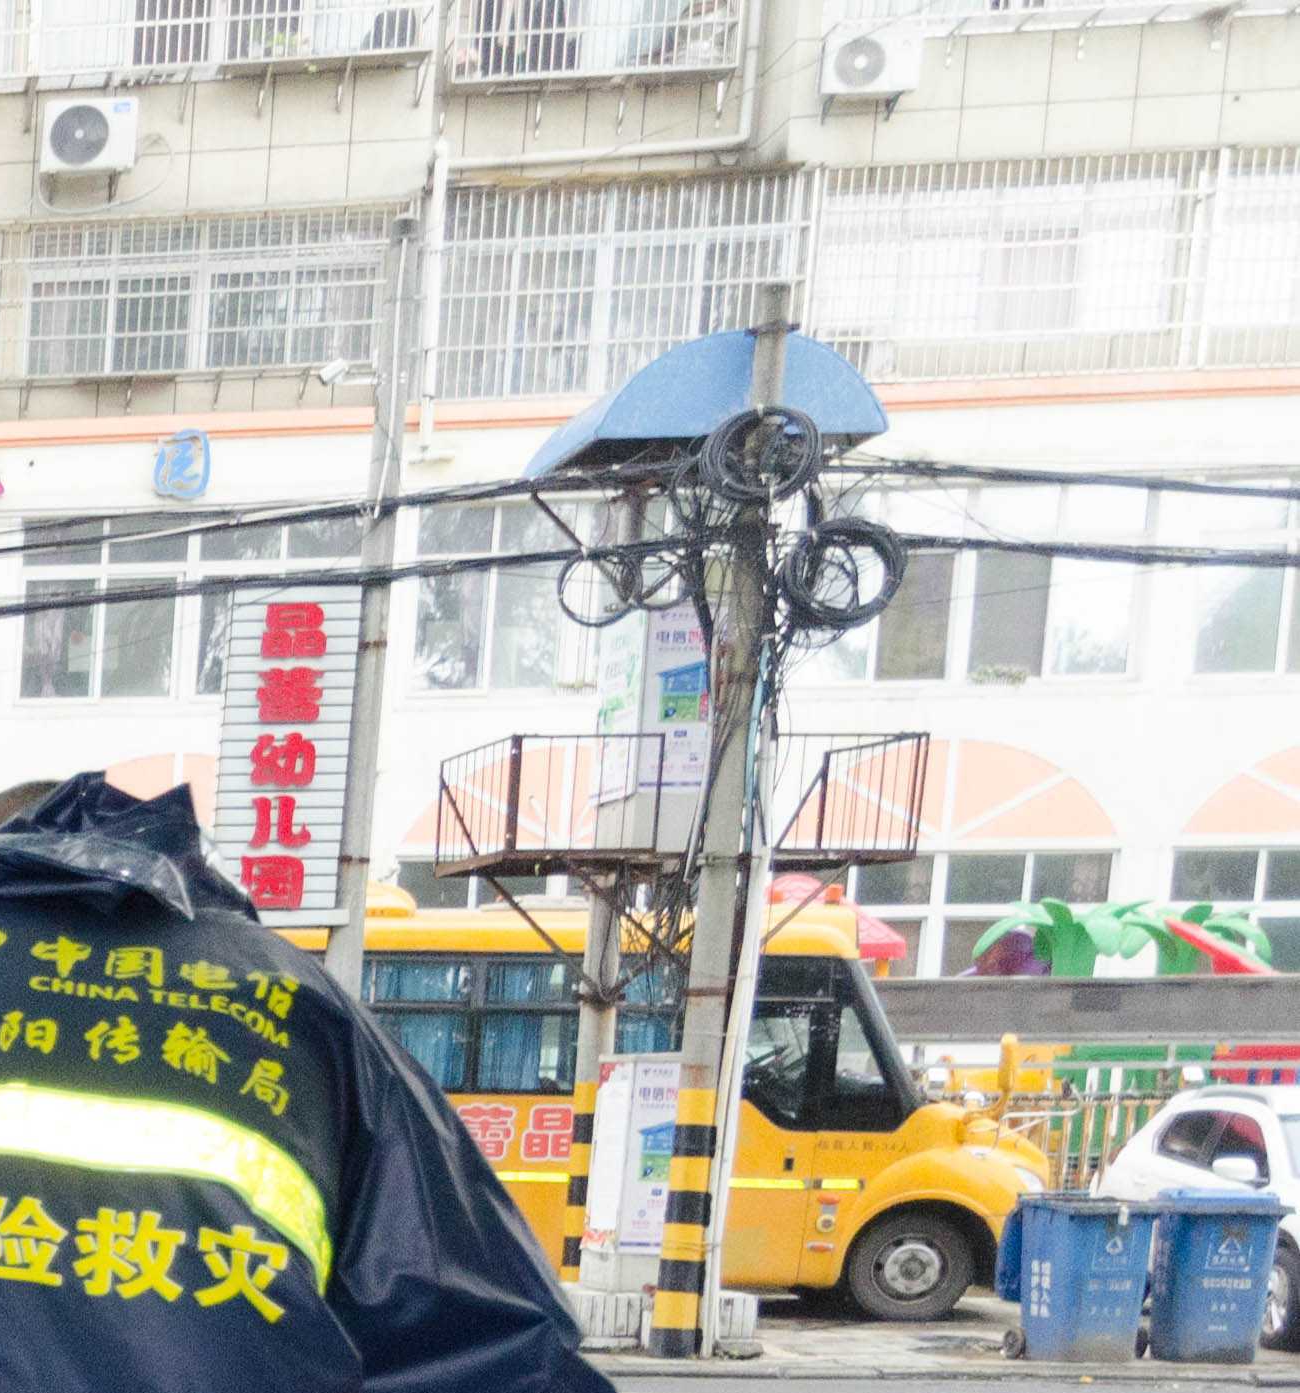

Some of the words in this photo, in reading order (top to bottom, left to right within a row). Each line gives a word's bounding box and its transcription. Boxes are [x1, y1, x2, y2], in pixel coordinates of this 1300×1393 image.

[240, 602, 328, 910] 晶蕾幼儿园
[29, 975, 139, 1003] CHINA
[148, 989, 291, 1049] TELECOM
[30, 936, 300, 1018] 中国电信
